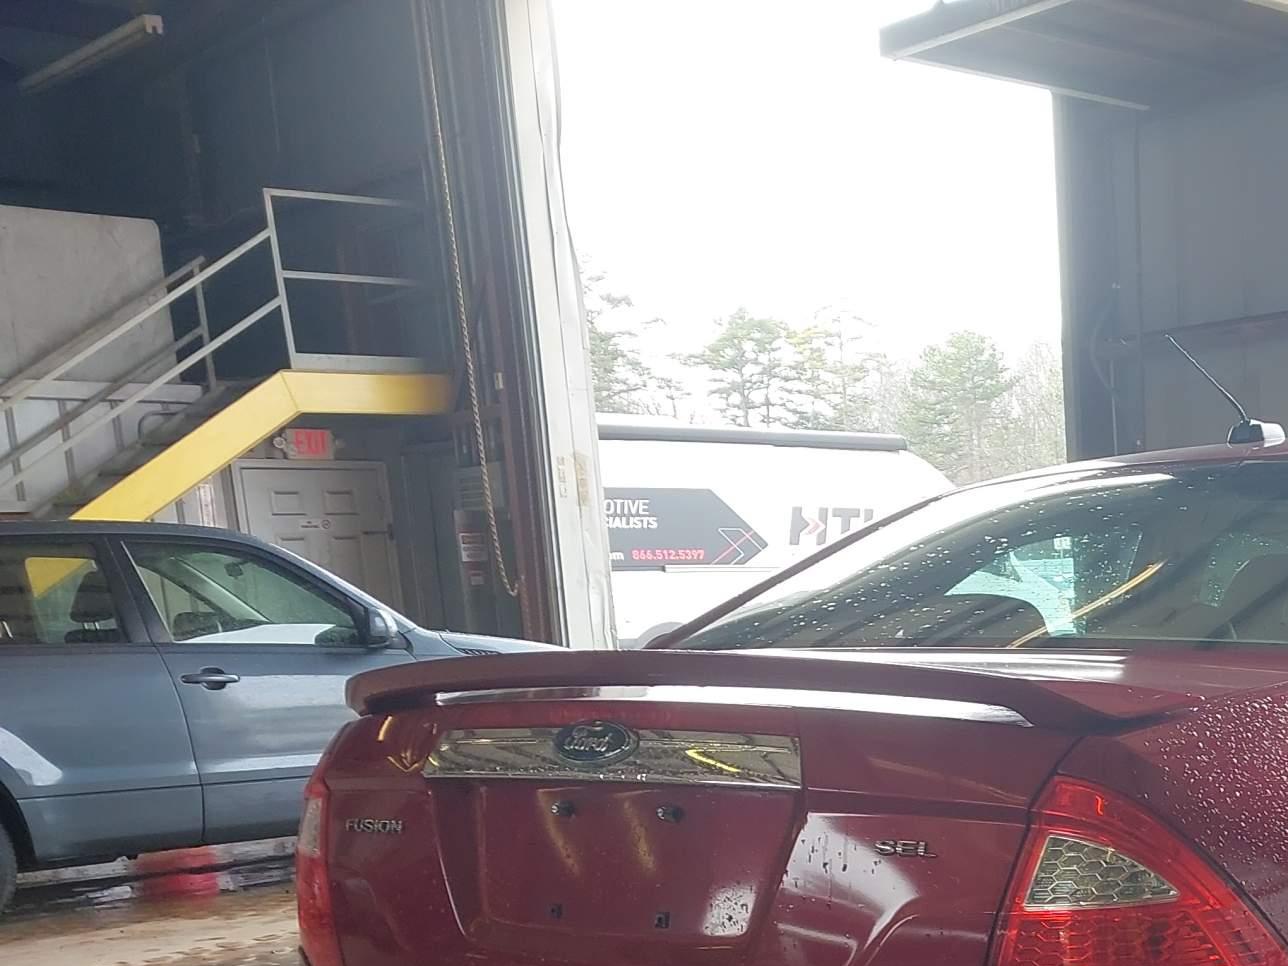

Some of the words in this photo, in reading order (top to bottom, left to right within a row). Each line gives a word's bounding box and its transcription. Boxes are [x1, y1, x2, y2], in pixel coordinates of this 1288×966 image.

[294, 430, 328, 455] EXIT
[563, 725, 612, 752] Ford
[345, 818, 403, 834] FUSION
[873, 839, 937, 857] SEL
